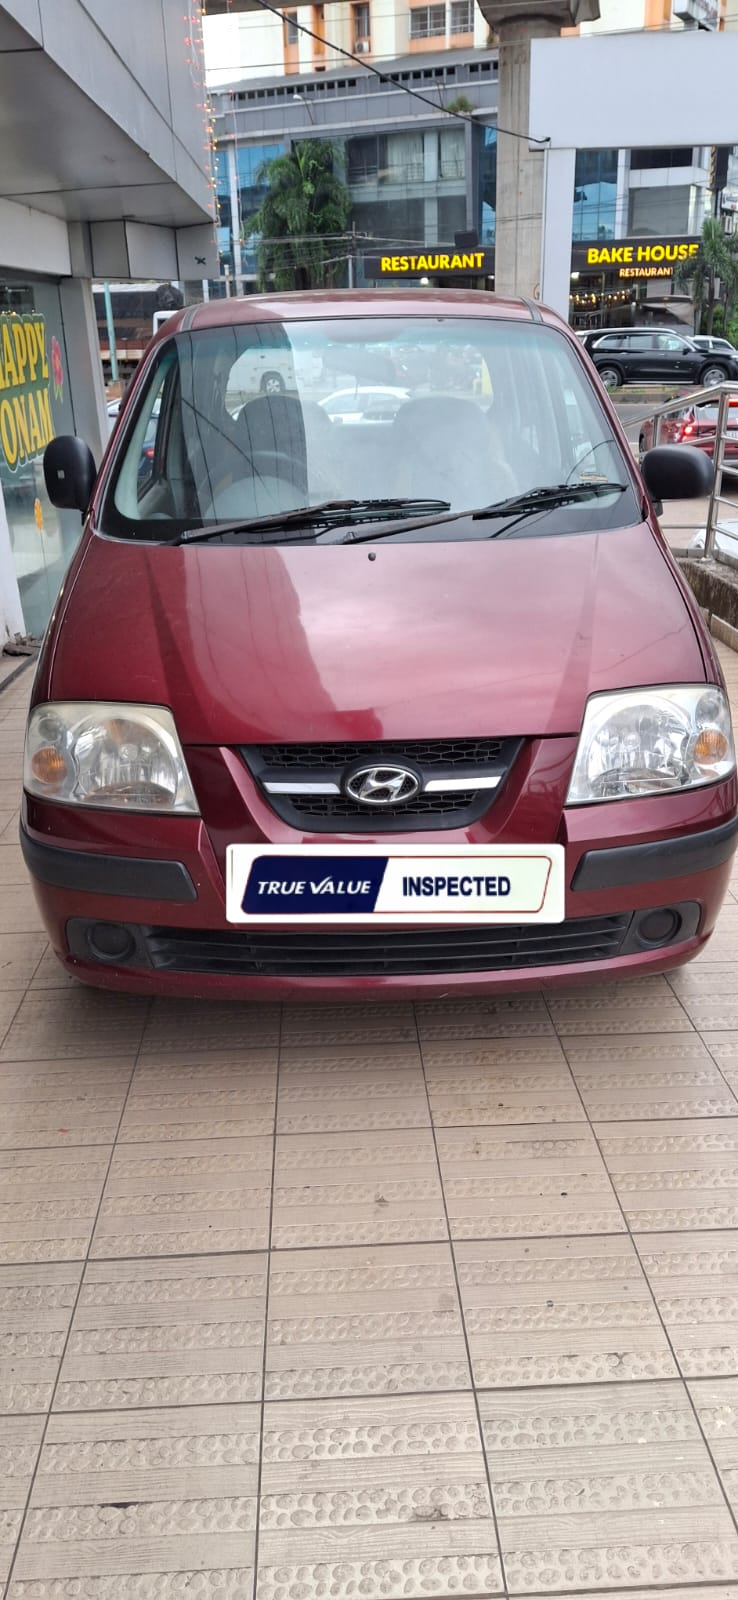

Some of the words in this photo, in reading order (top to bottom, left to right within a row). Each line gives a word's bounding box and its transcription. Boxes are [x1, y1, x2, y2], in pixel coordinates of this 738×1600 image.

[381, 252, 485, 271] RESTAURANT
[587, 247, 633, 264] BAKE
[637, 244, 699, 261] HOUSE
[0, 323, 49, 389] APPY
[0, 388, 54, 464] ONAM
